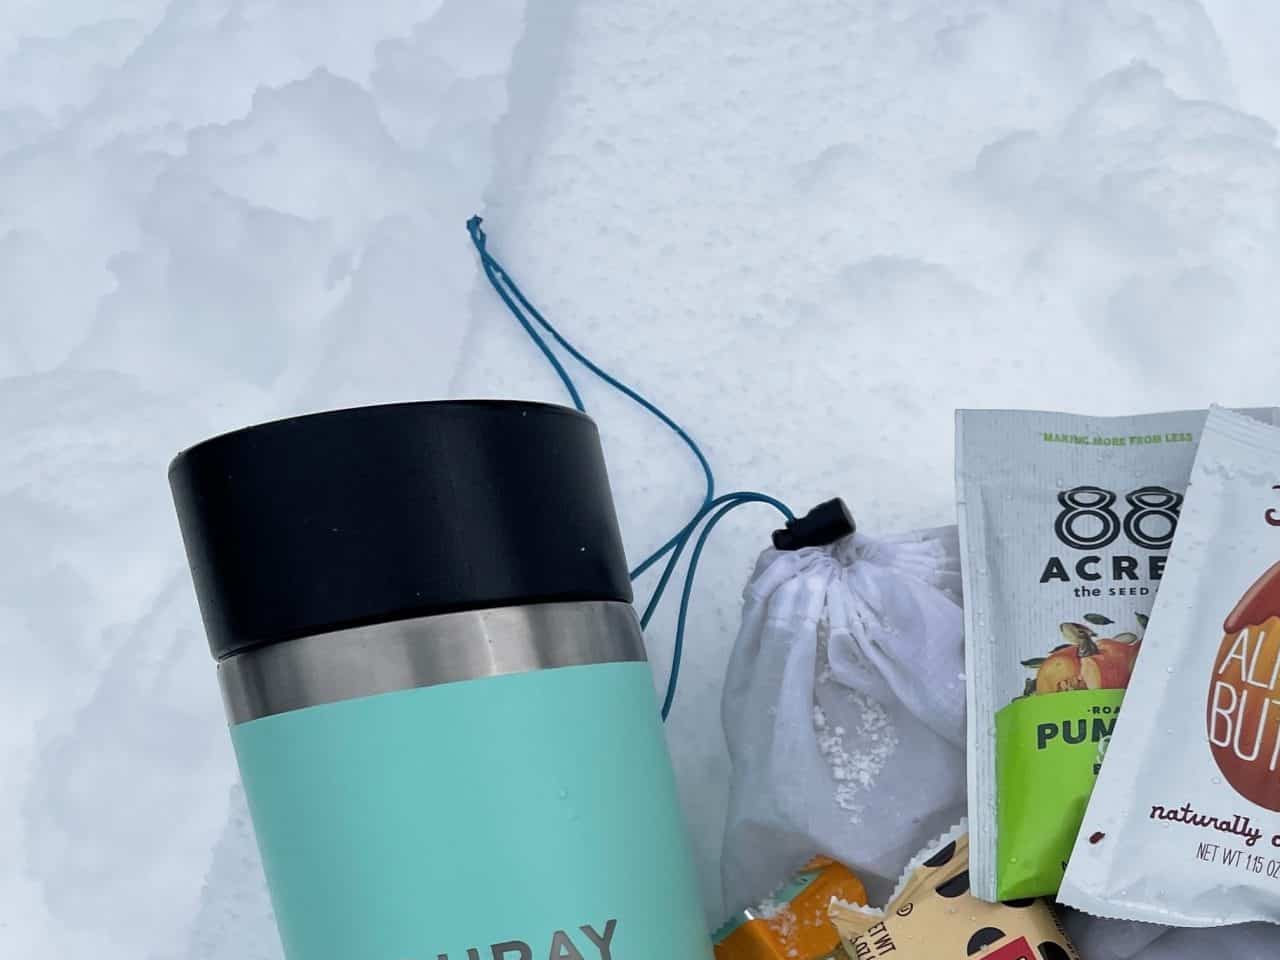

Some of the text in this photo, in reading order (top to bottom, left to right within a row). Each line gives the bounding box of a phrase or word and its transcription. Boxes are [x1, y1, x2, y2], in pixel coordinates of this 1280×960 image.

[1043, 432, 1193, 446] MAKING MORE FROM LESS
[1054, 486, 1184, 550] 88
[1074, 586, 1149, 598] the SEED
[1150, 803, 1263, 847] naturally
[1196, 842, 1220, 863] NET
[1222, 848, 1243, 867] WT
[875, 934, 897, 956] WT
